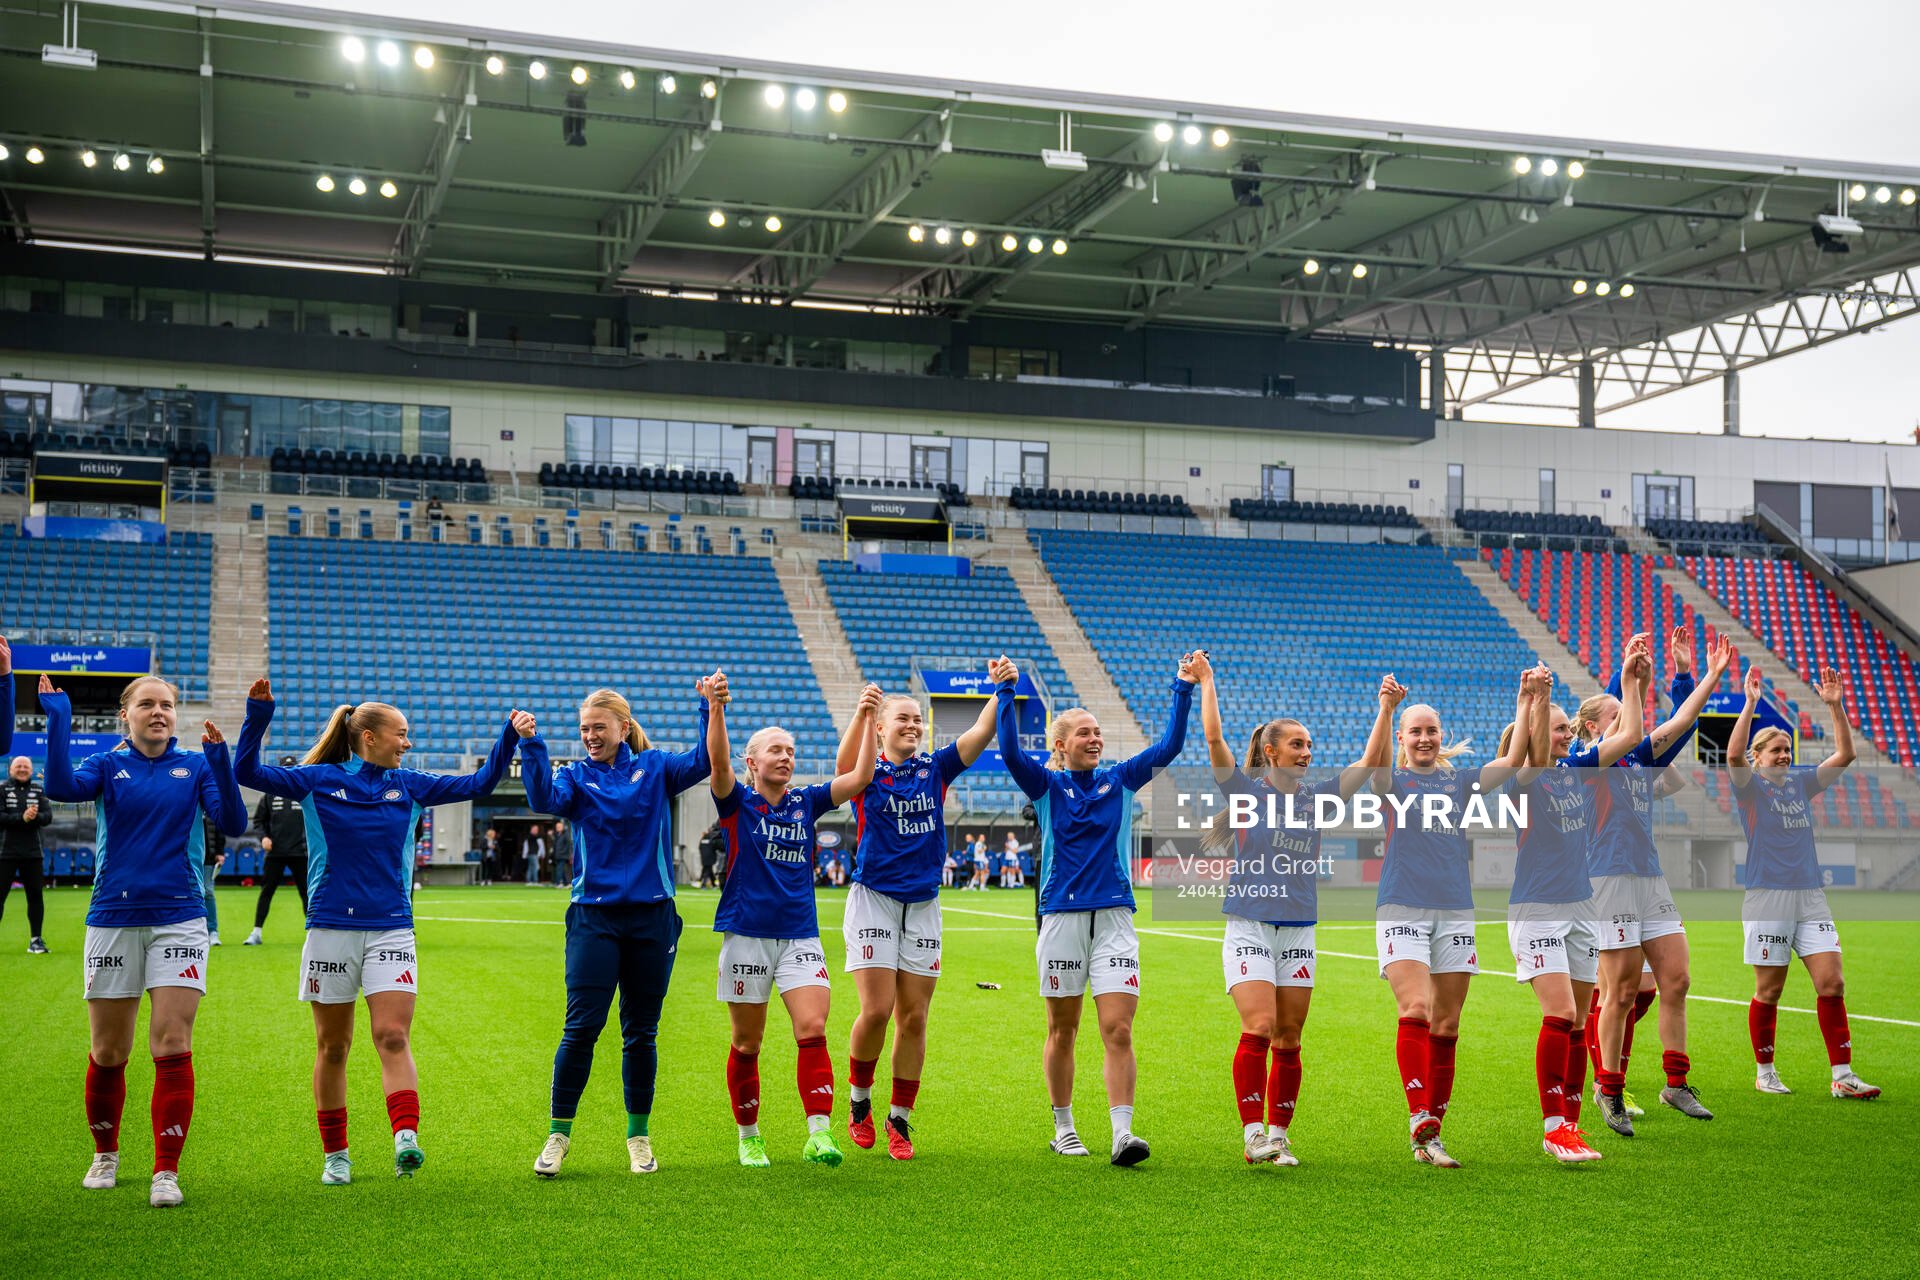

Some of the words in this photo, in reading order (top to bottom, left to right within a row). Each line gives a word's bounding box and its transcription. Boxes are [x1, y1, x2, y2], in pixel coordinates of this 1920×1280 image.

[883, 792, 936, 818] Aprila
[1632, 796, 1649, 813] Ban
[752, 817, 808, 841] Aprila
[1272, 830, 1313, 854] Bank
[765, 843, 807, 863] Bank
[1617, 928, 1625, 942] 3
[862, 945, 874, 960] 10
[1387, 942, 1394, 956] 4
[1762, 948, 1769, 960] 9
[1240, 961, 1248, 976] 6
[1533, 954, 1545, 969] 21
[309, 978, 320, 994] 16
[734, 980, 744, 996] 18
[1049, 975, 1059, 990] 19
